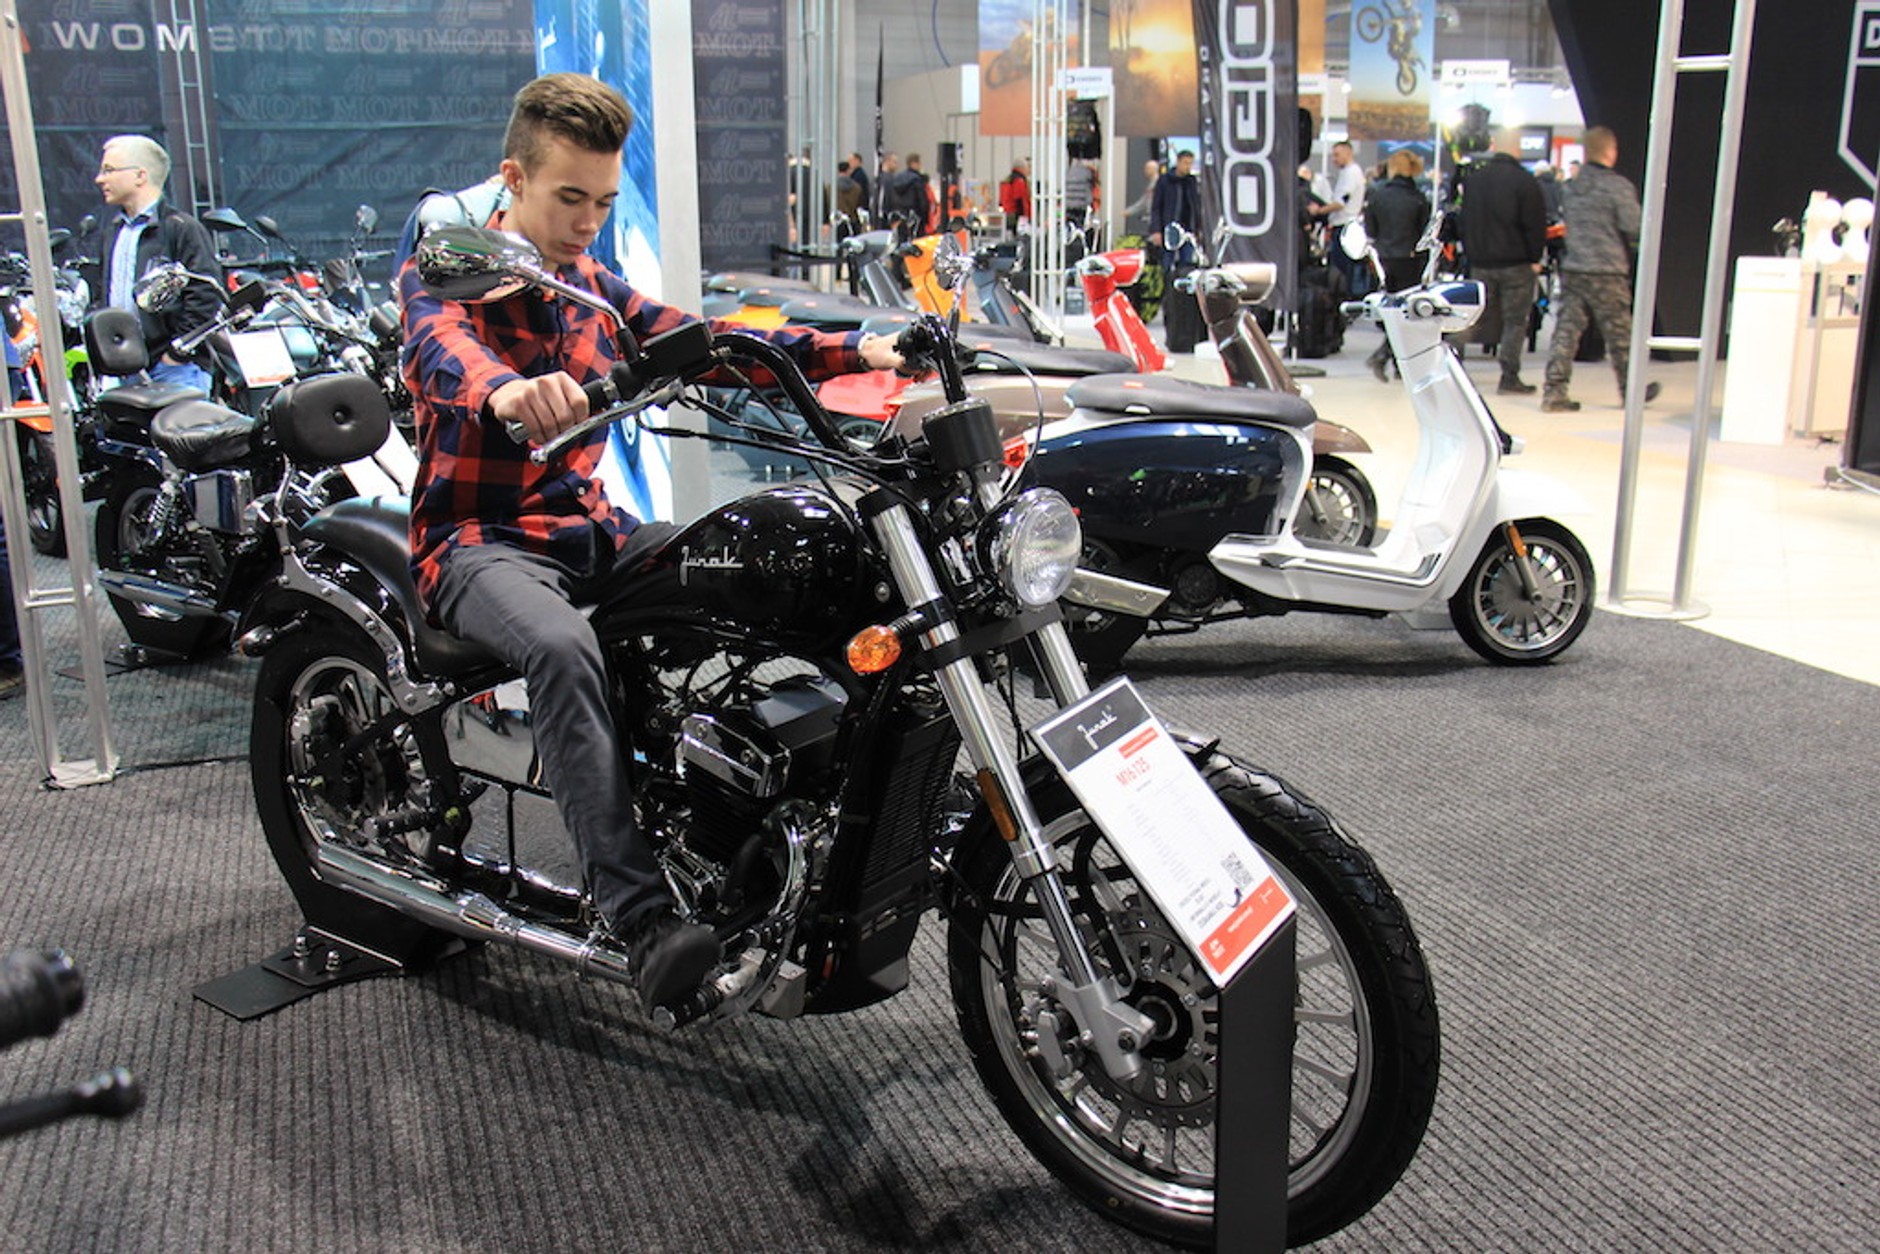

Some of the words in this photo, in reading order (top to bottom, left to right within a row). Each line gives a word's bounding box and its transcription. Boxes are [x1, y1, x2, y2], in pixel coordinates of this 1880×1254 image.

[696, 31, 776, 58] MOT
[699, 96, 777, 122] MOT
[1218, 0, 1275, 236] OGIO
[701, 159, 777, 184] MOT
[703, 221, 777, 246] MOT
